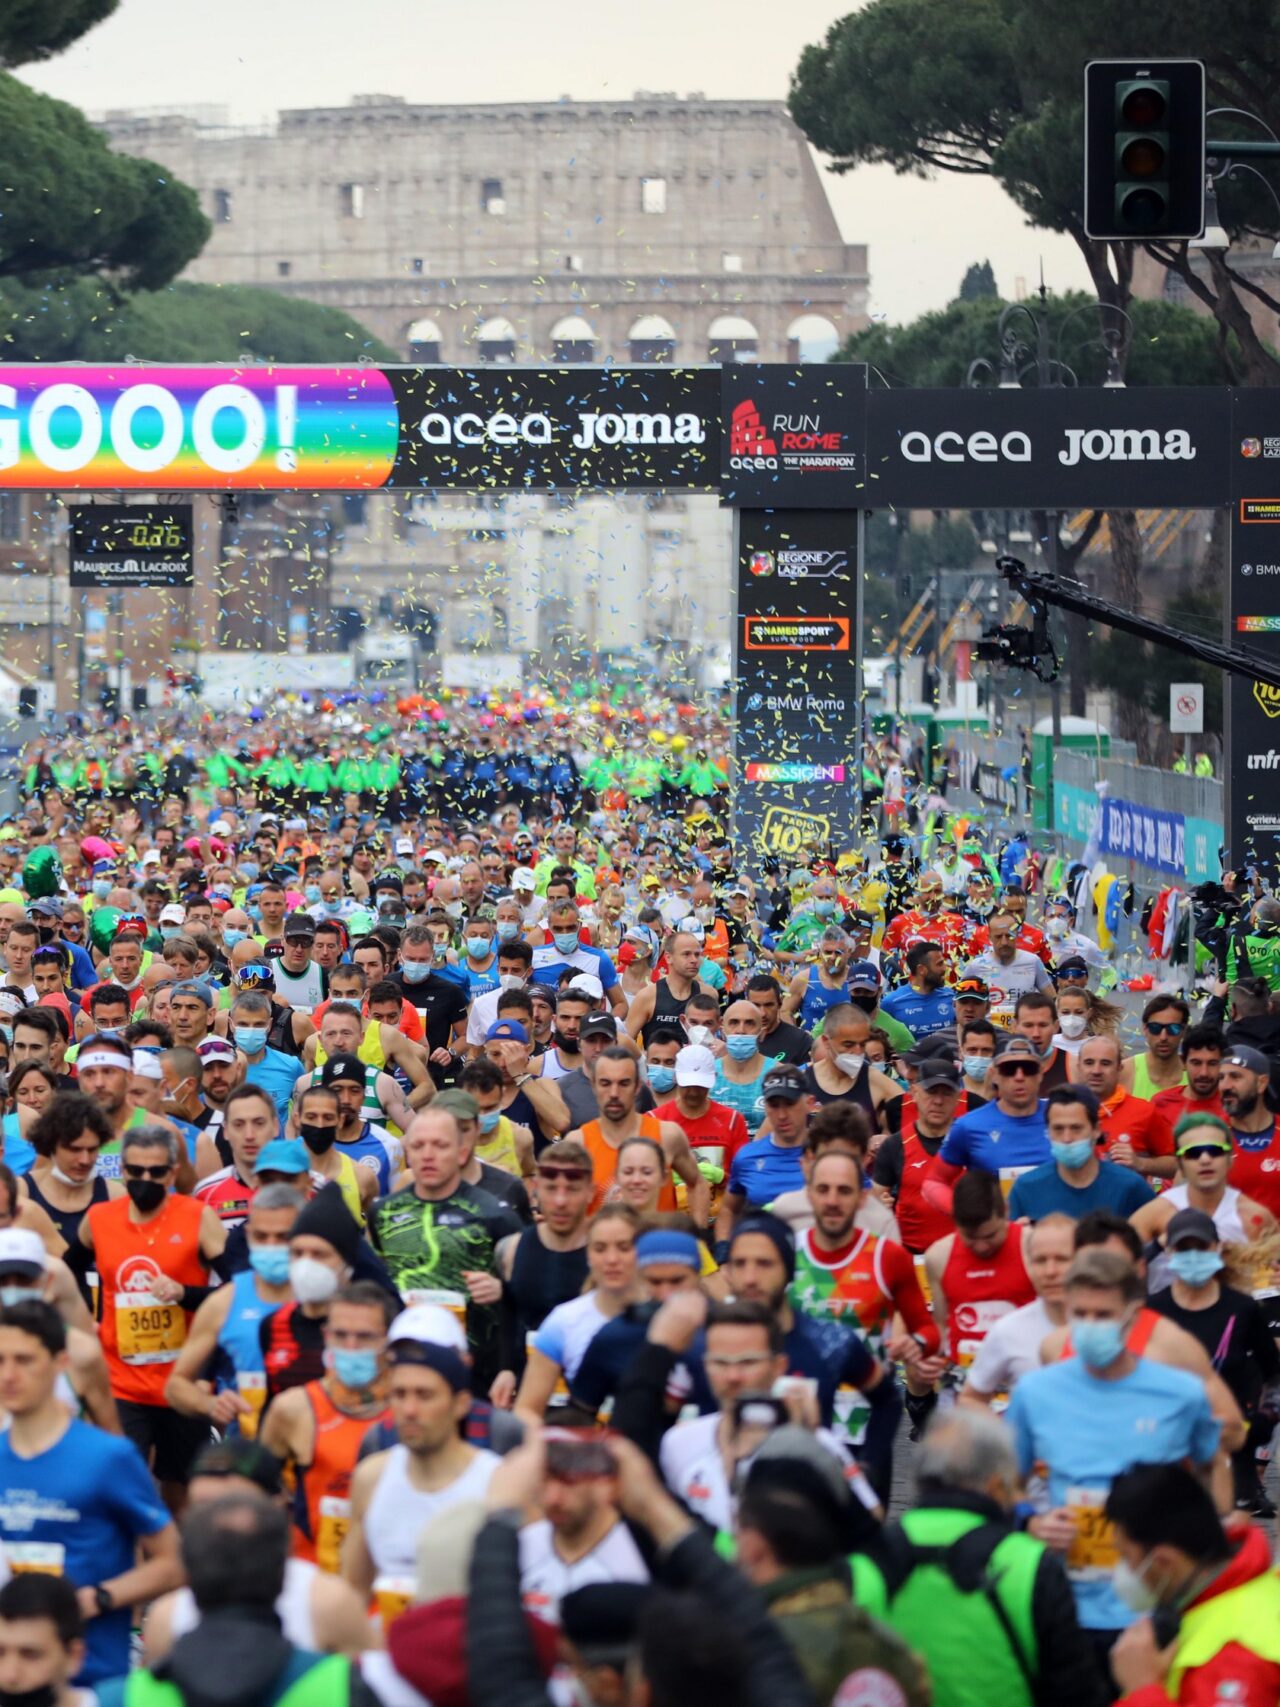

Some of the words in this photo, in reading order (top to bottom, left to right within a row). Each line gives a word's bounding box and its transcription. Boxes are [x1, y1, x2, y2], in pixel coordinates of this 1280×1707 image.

[421, 413, 552, 445] acea
[773, 414, 820, 432] RUN
[782, 432, 841, 449] ROME
[900, 430, 1031, 462] acea
[730, 457, 778, 470] acea
[800, 457, 854, 467] MARATHON
[778, 552, 823, 563] REGIONE
[141, 561, 188, 573] LACROIX
[778, 565, 809, 575] LAZIO
[767, 696, 803, 710] BMW
[806, 696, 845, 711] Roma
[756, 766, 835, 780] MASSIGEN
[656, 1015, 679, 1023] FLEET
[129, 1308, 172, 1331] 3603
